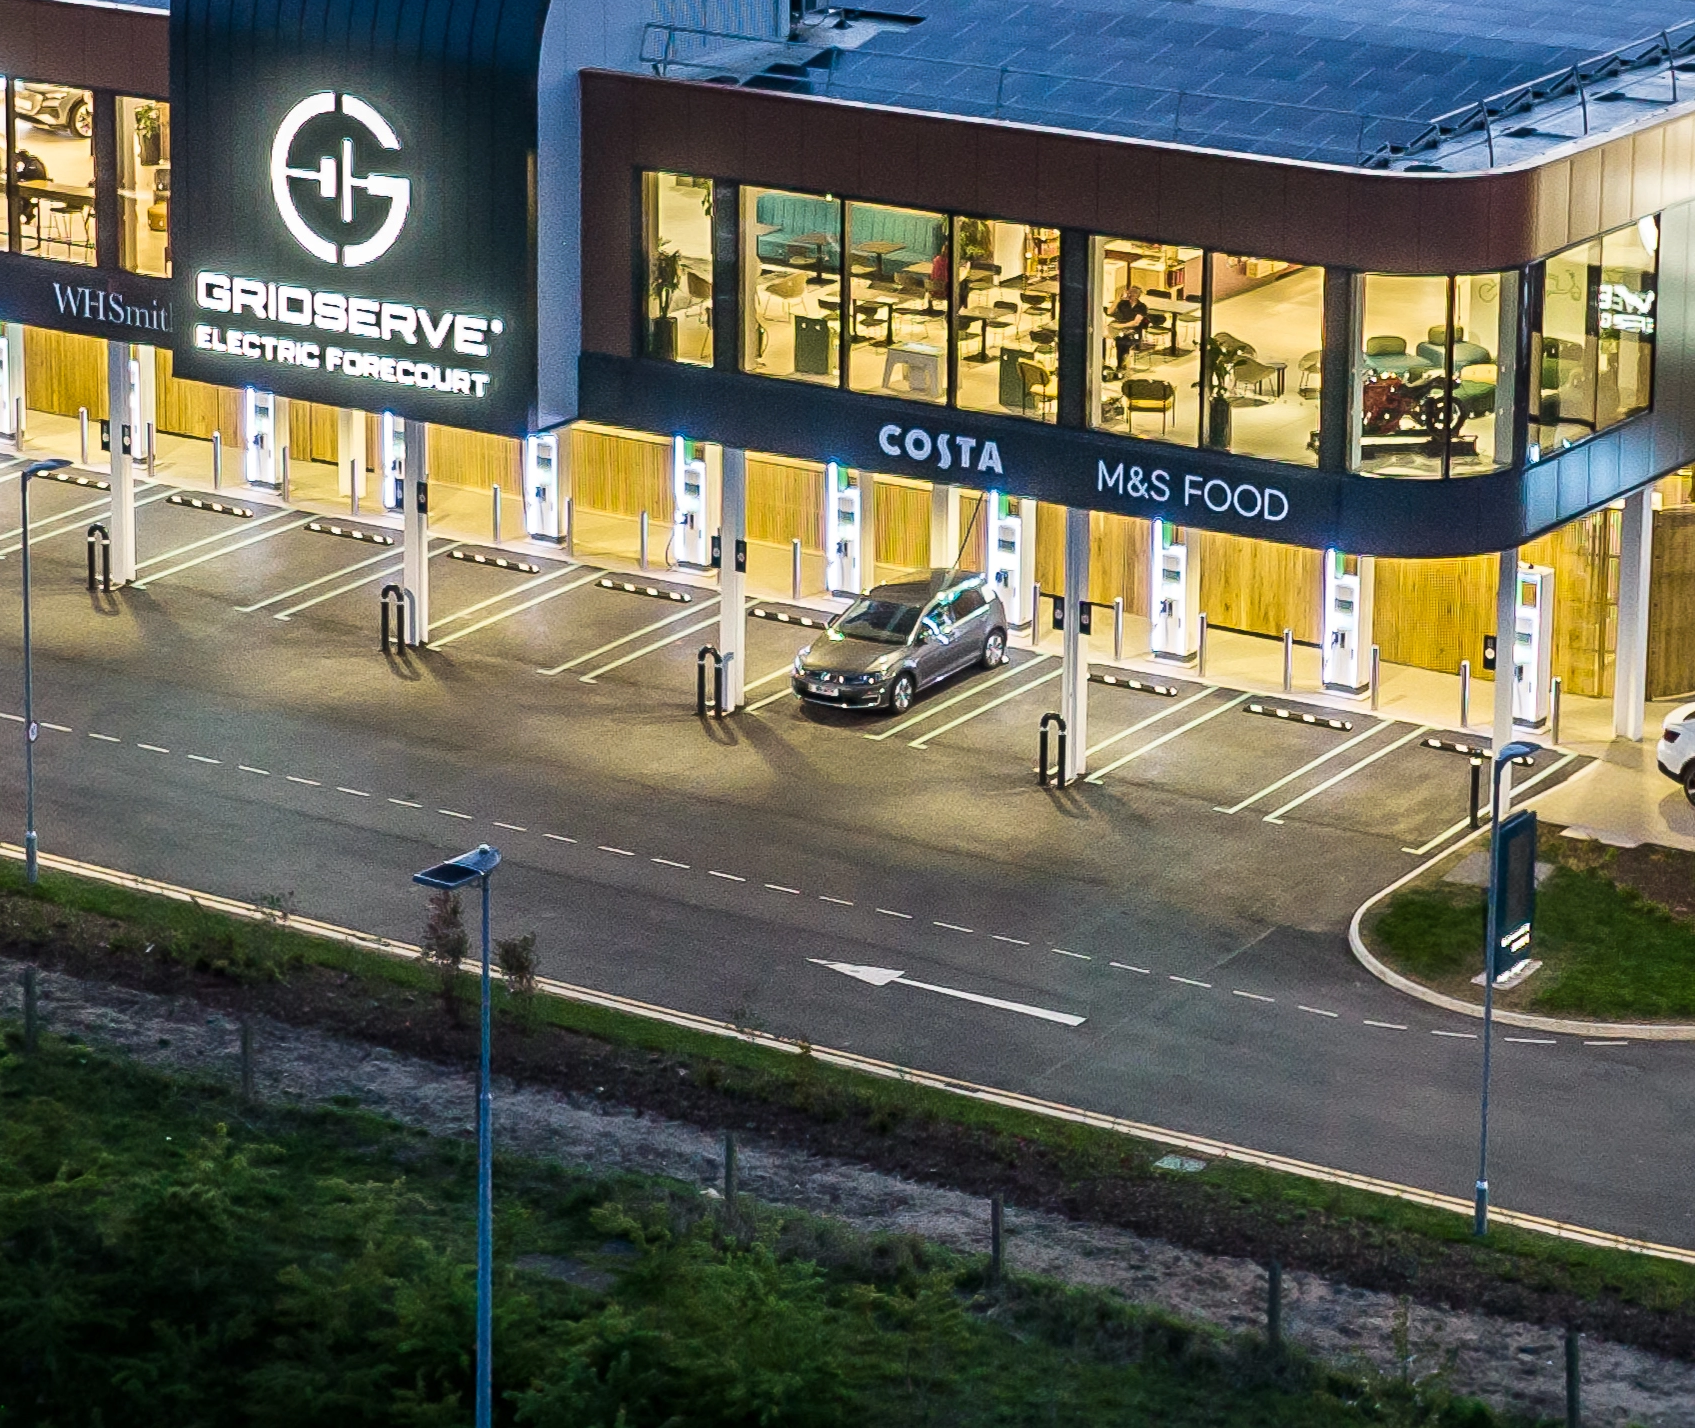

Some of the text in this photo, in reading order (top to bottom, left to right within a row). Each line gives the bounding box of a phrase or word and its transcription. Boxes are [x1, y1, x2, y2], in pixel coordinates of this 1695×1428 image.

[196, 324, 491, 399] ELECTRIC FORECOURT
[878, 424, 1005, 474] COSTA
[1096, 458, 1290, 523] M&S FOOD
